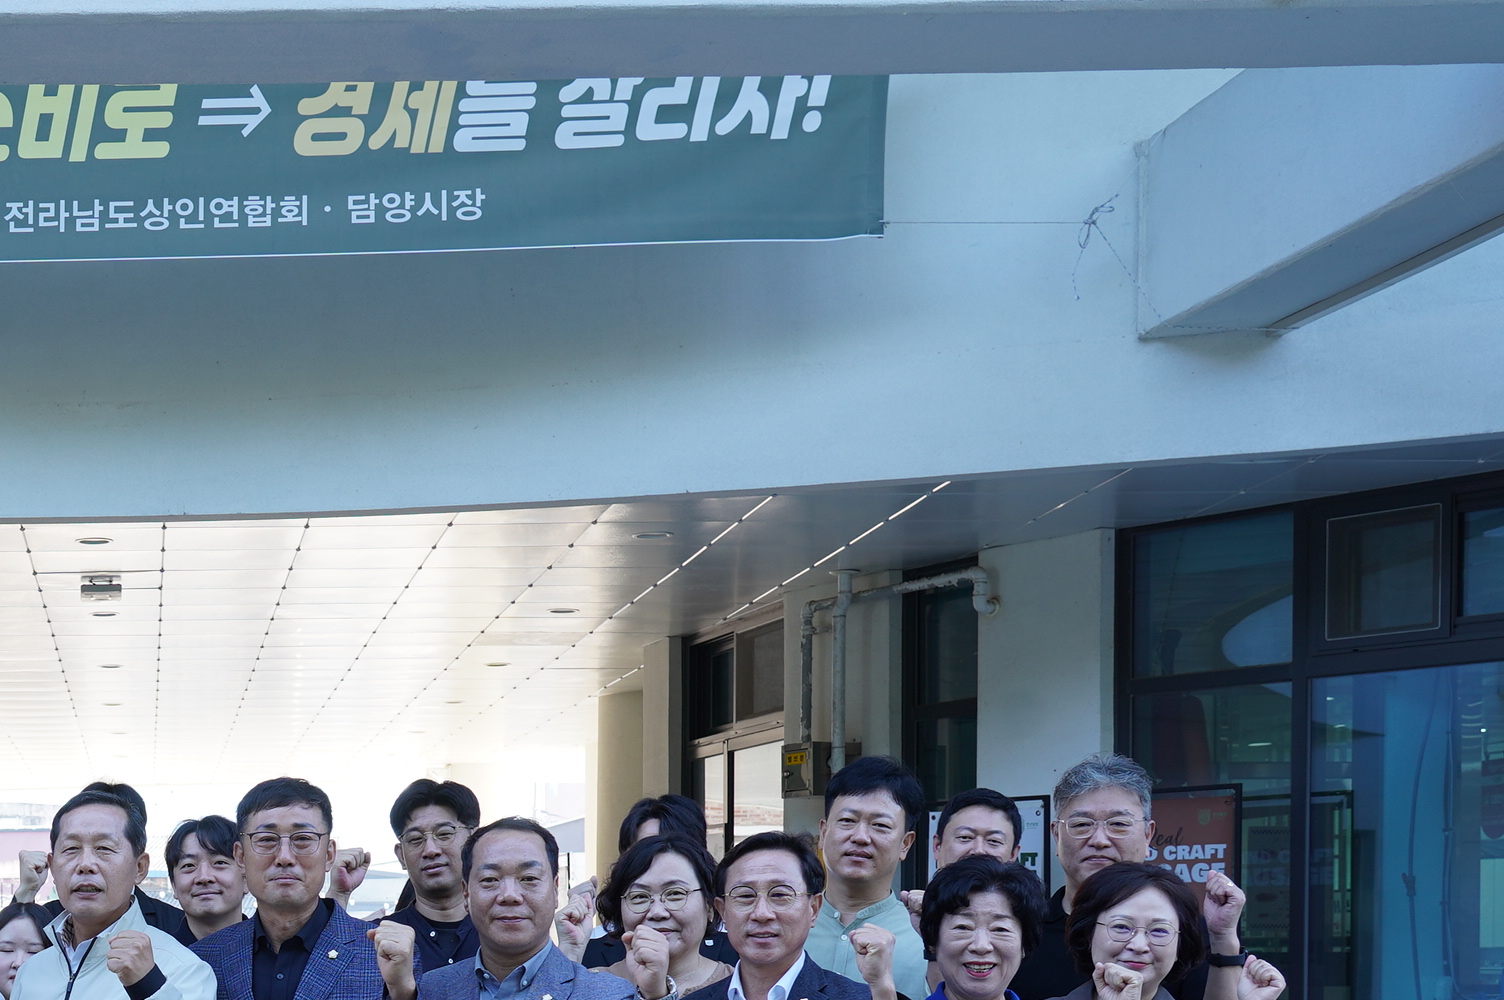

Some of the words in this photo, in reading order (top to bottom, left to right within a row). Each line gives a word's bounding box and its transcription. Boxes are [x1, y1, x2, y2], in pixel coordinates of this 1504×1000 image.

[3, 194, 308, 233] 전라남도상인연합회
[346, 187, 486, 225] 담양시장
[1163, 843, 1227, 861] CRAFT
